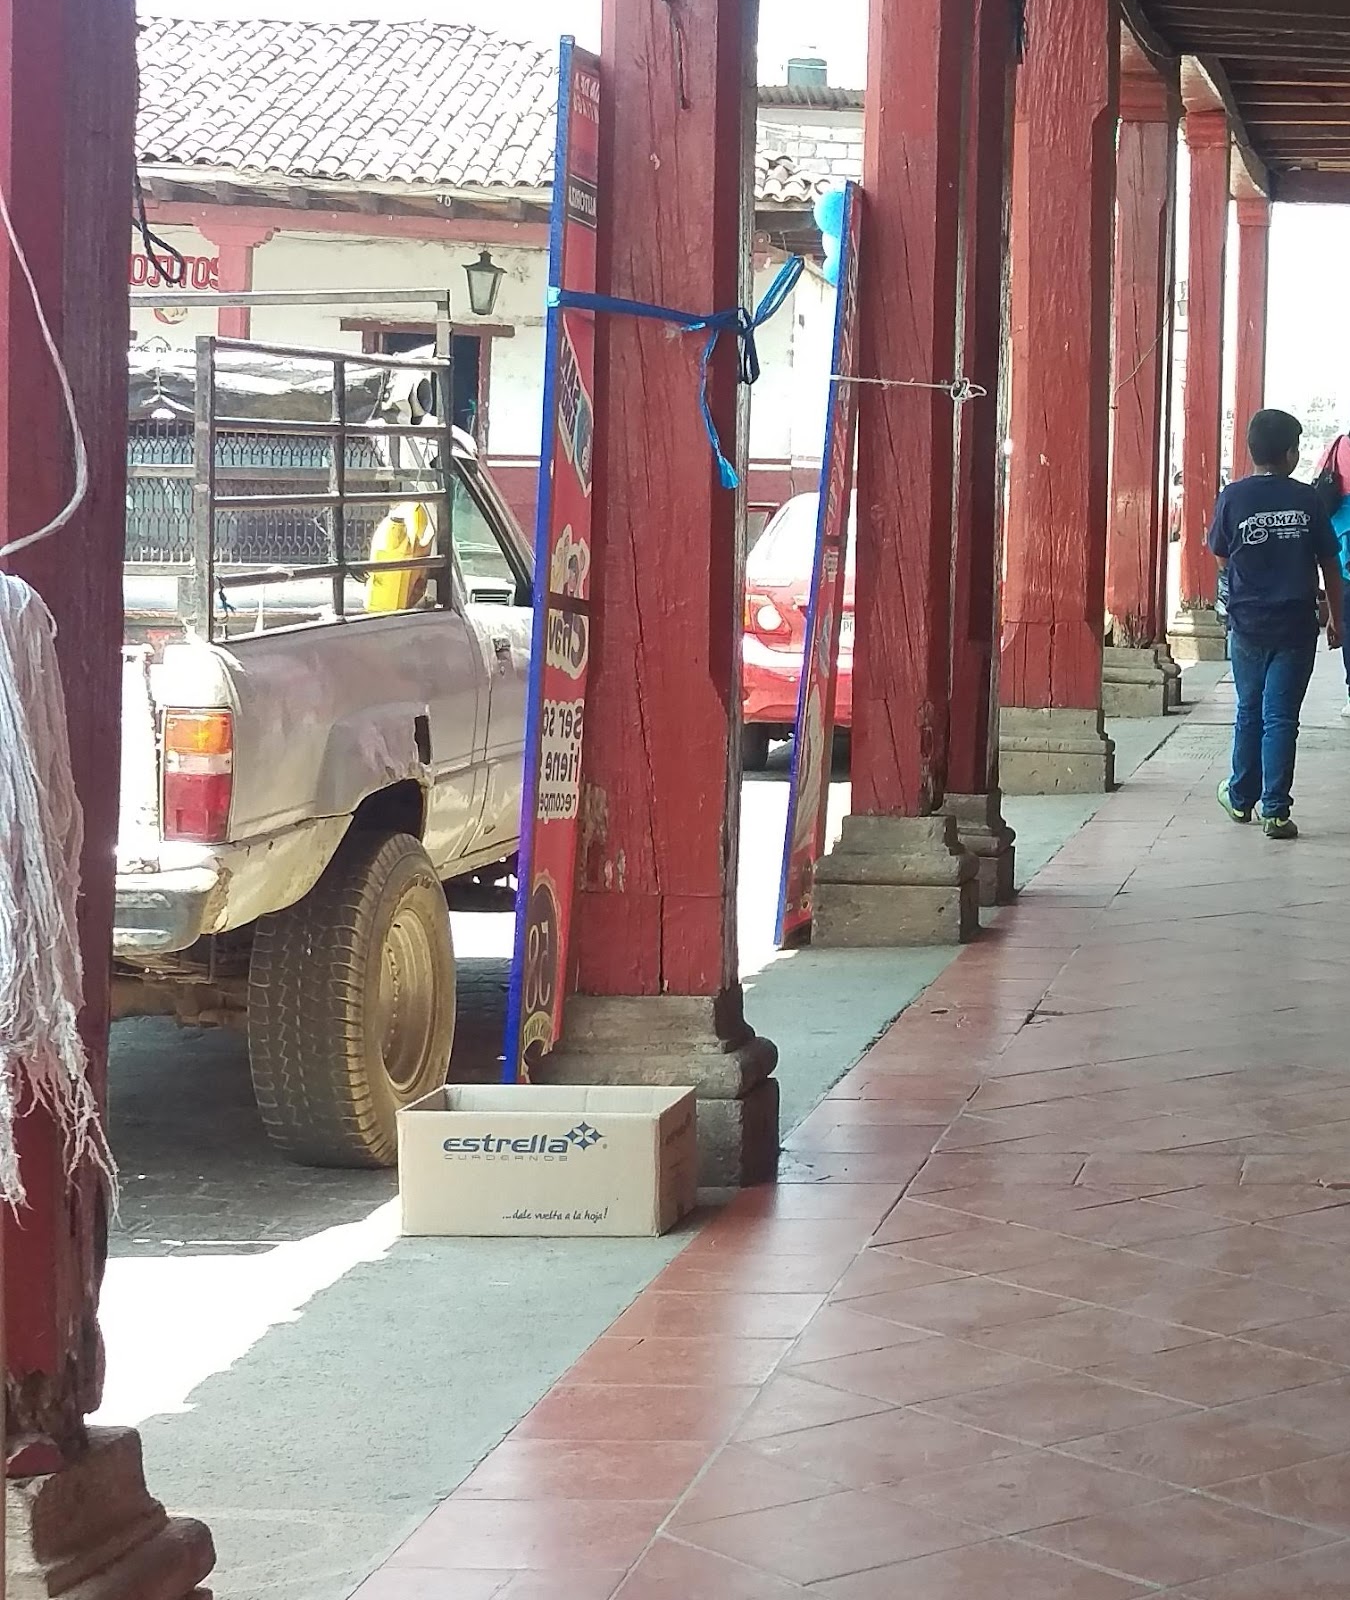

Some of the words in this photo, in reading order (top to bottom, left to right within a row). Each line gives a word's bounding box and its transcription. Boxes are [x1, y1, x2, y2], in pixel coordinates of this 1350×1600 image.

[443, 1133, 569, 1153] estrella
[535, 1210, 562, 1220] vuelta
[573, 1209, 583, 1220] la
[584, 1206, 609, 1224] hoja!
